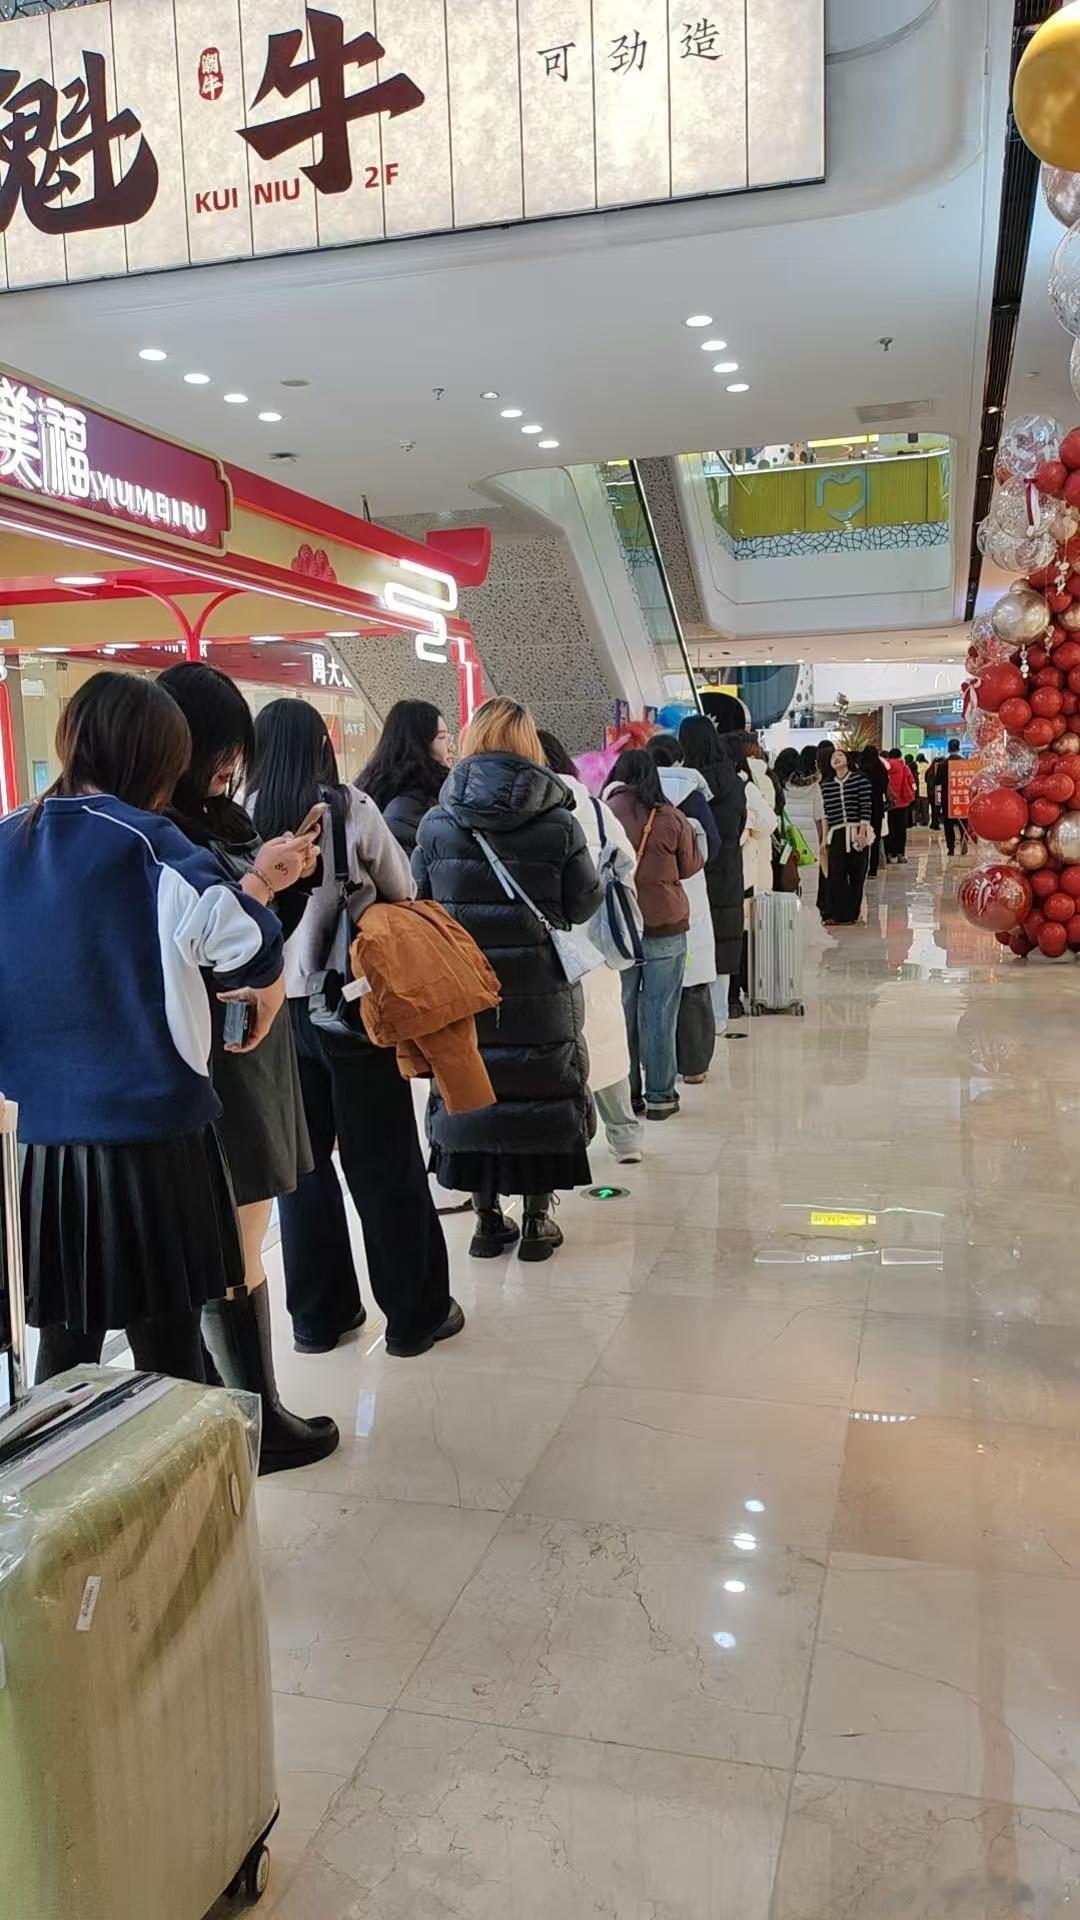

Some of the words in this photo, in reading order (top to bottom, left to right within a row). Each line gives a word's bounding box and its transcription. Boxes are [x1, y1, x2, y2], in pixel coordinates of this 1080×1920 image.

[536, 17, 723, 82] 可劲造
[0, 8, 425, 234] 魁牛
[195, 187, 239, 214] KUI
[253, 178, 300, 205] NIU
[364, 163, 399, 189] 2F
